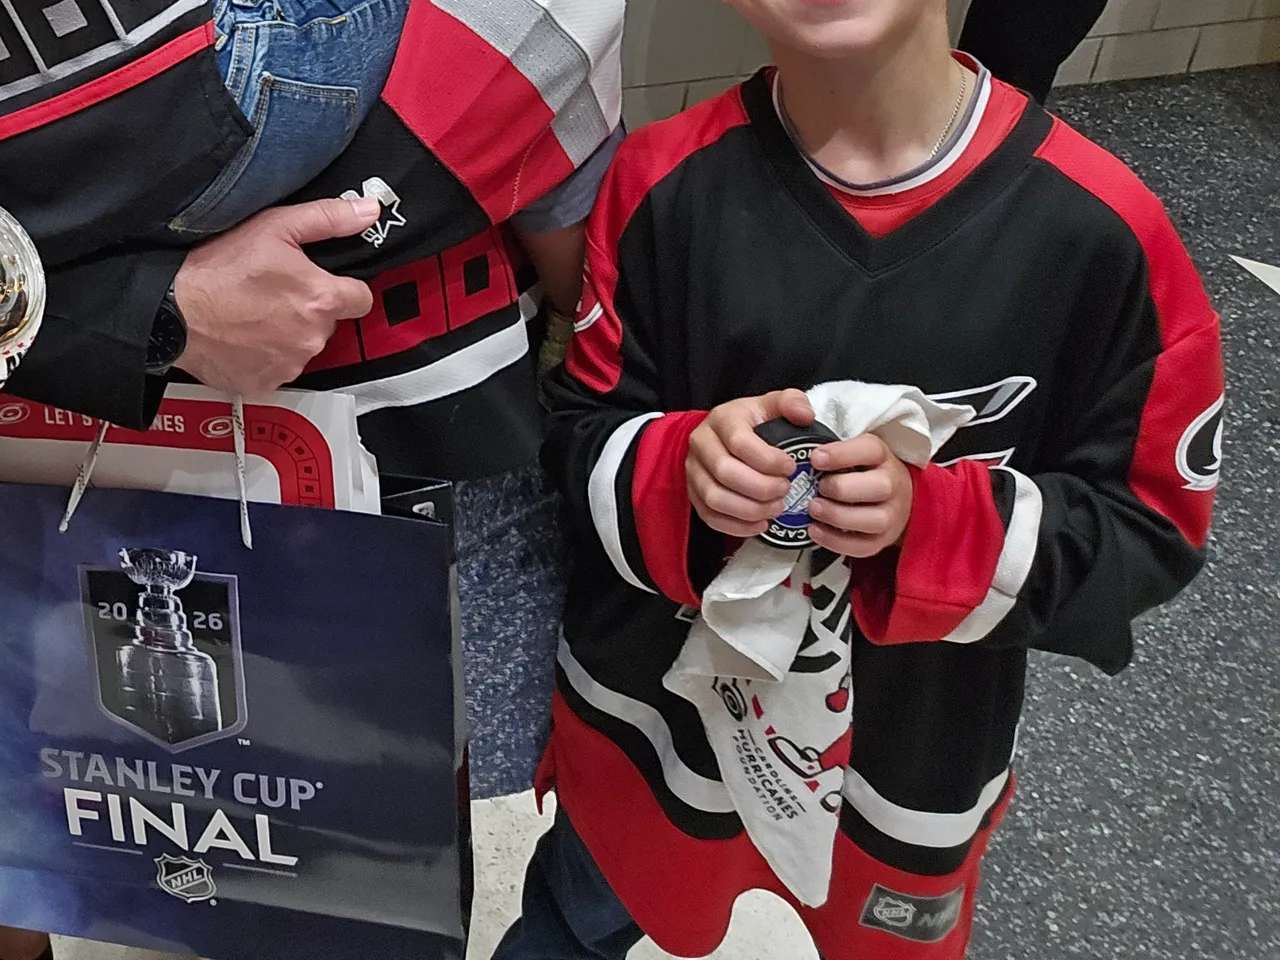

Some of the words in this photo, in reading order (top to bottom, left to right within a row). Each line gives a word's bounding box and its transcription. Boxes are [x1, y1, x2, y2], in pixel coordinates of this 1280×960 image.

[150, 415, 185, 433] NES
[769, 524, 808, 540] CAPS
[98, 602, 127, 620] 20
[193, 611, 223, 630] 26
[39, 746, 221, 800] STANLEY
[233, 771, 316, 811] CUP
[737, 728, 798, 820] HURRICANES
[64, 787, 298, 866] FINAL
[171, 866, 203, 889] NHL
